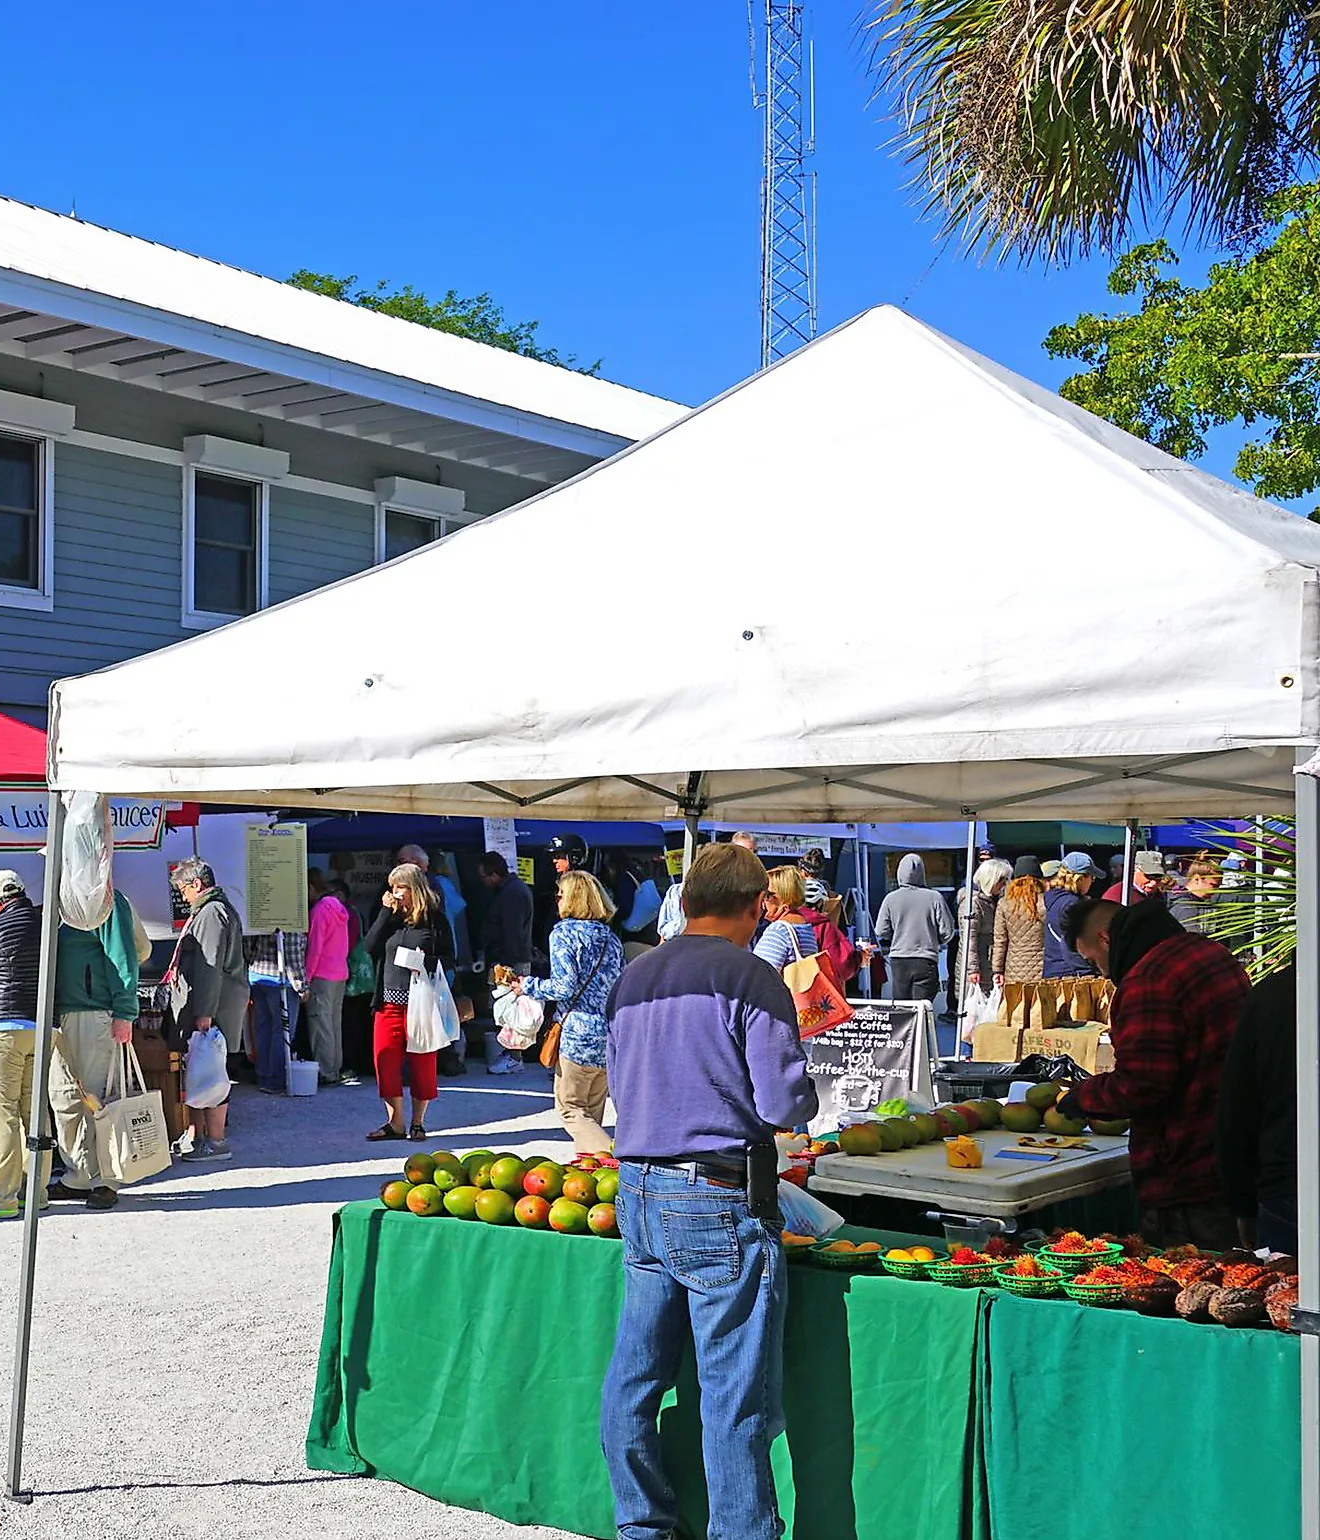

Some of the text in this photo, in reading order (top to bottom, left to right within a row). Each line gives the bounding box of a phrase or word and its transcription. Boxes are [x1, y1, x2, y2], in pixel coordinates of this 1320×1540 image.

[110, 806, 163, 827] auces
[860, 1021, 893, 1031] Coffee
[831, 1038, 844, 1048] bag
[873, 1040, 886, 1048] for
[1056, 1038, 1072, 1049] DO
[806, 1063, 909, 1079] Coffee-by-the-cup
